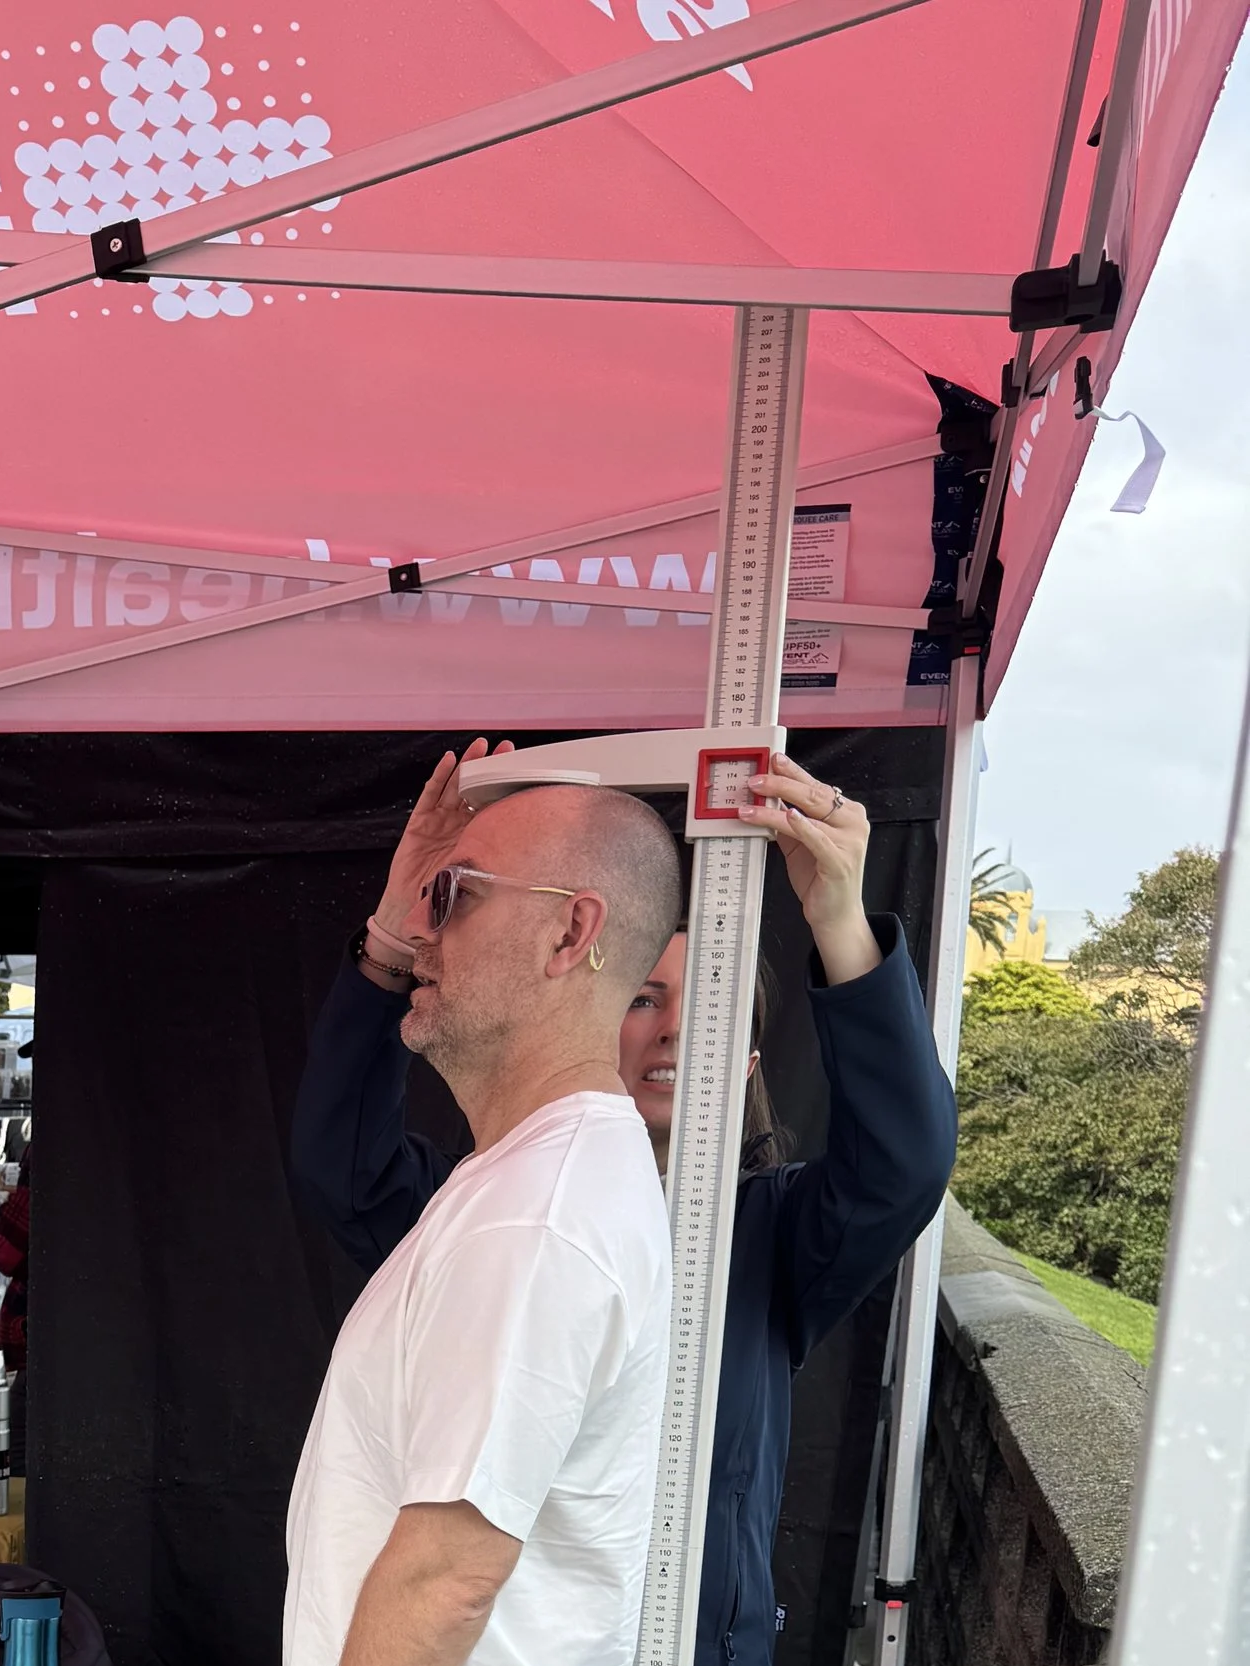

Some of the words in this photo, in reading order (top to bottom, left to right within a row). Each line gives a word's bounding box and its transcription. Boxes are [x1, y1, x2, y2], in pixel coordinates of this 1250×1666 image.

[760, 328, 772, 336] 207
[759, 342, 771, 350] 206
[751, 424, 767, 433] 200
[742, 560, 756, 568] 190
[731, 693, 745, 701] 180
[711, 951, 724, 959] 160
[700, 1076, 714, 1084] 150
[689, 1198, 703, 1206] 140
[668, 1434, 682, 1442] 120
[650, 1659, 662, 1666] 100
